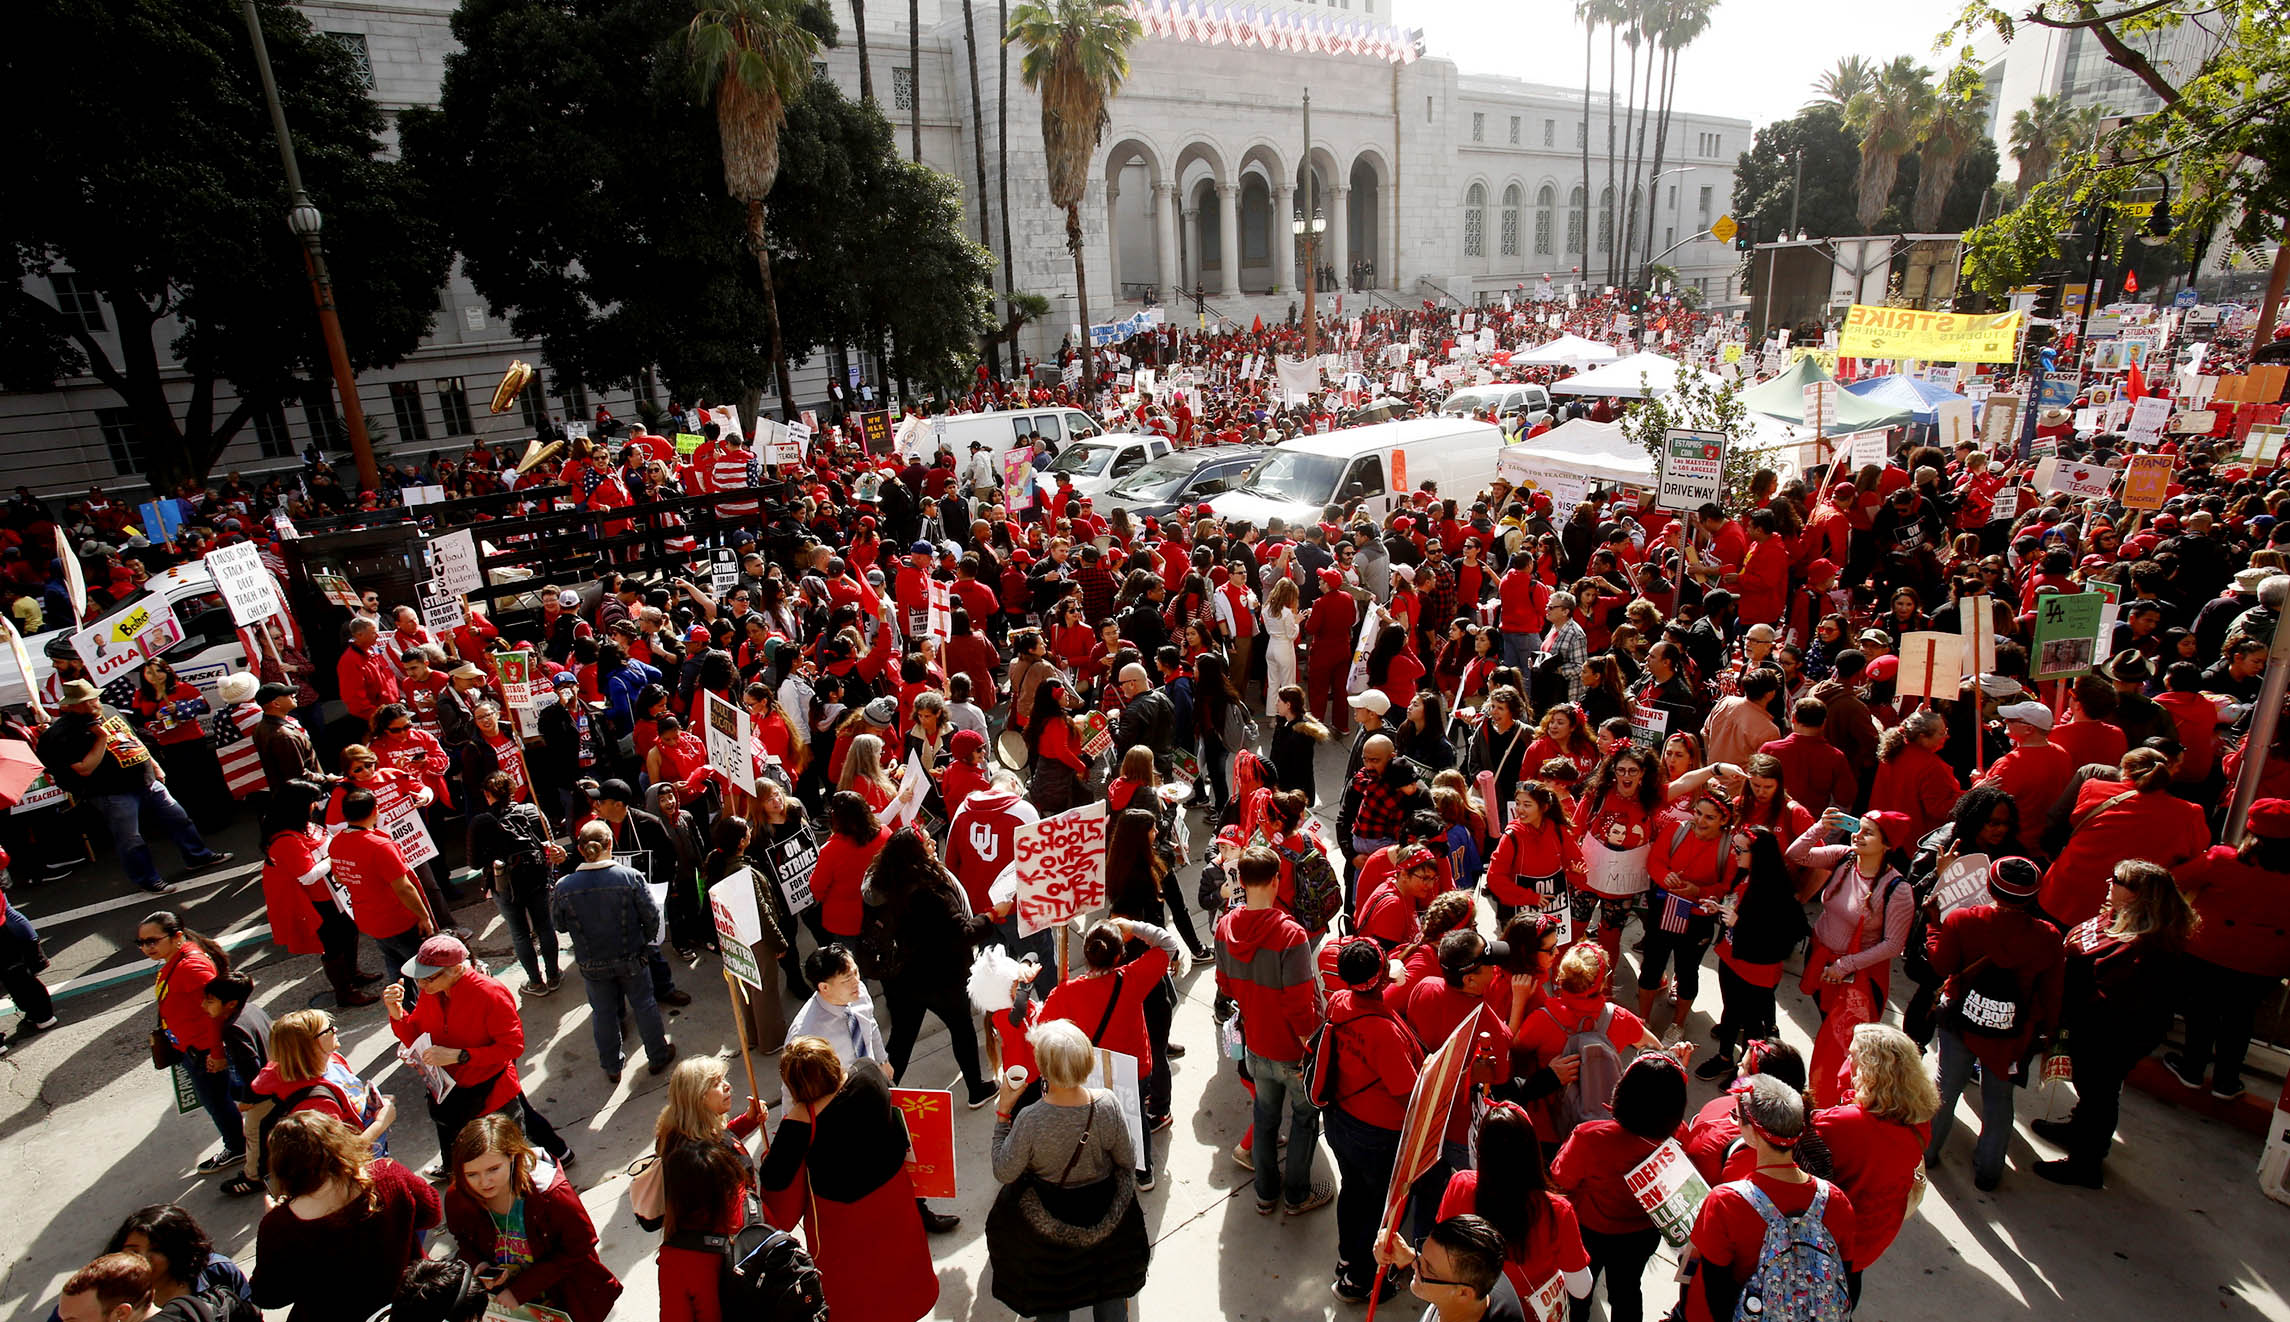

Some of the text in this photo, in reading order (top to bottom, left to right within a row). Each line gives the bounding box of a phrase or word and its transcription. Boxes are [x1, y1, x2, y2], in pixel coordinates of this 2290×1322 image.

[2177, 297, 2194, 305] BUS
[2125, 328, 2160, 336] STUDENTS
[1674, 440, 1702, 448] ESTAMOS
[1680, 448, 1694, 456] CON
[1690, 466, 1717, 474] ANGELES
[2060, 464, 2071, 474] I
[2133, 458, 2172, 468] STAND
[1664, 482, 1714, 500] DRIVEWAY
[2136, 480, 2156, 492] LA
[1907, 524, 1920, 537] ON
[236, 544, 255, 556] SAYS
[719, 550, 728, 562] ON
[222, 565, 246, 580] STACK
[712, 562, 736, 574] STRIKE
[237, 575, 256, 591] DEEP
[234, 593, 258, 608] TEACH
[247, 602, 272, 619] CHEAP!
[430, 605, 454, 618] FOR OUR
[430, 612, 458, 626] STUDENTS
[96, 648, 140, 676] UTLA
[712, 702, 729, 720] ADULT
[1632, 727, 1654, 740] URSE
[712, 732, 742, 762] IN THE
[711, 749, 740, 778] HOUSE
[1172, 768, 1194, 784] CHERS
[384, 799, 413, 822] STRIKE
[392, 822, 414, 841] AUSD
[1038, 812, 1081, 836] OUR
[402, 830, 424, 846] UNFAIR
[970, 821, 998, 862] OU
[402, 842, 420, 856] ABOR
[784, 838, 802, 858] ON
[778, 846, 818, 881] STRIKE
[1040, 846, 1104, 868] OUR
[1451, 846, 1465, 880] 17
[790, 876, 804, 892] FOR
[1046, 874, 1088, 897] OUR
[1536, 878, 1554, 896] ON
[1018, 881, 1104, 931] FUTURE
[1968, 989, 2016, 1012] CARSON
[1962, 1006, 1985, 1026] BOOT
[1964, 998, 2016, 1023] FIT BODY
[1626, 1146, 1677, 1194] UDENTS
[1540, 1274, 1565, 1307] OUR
